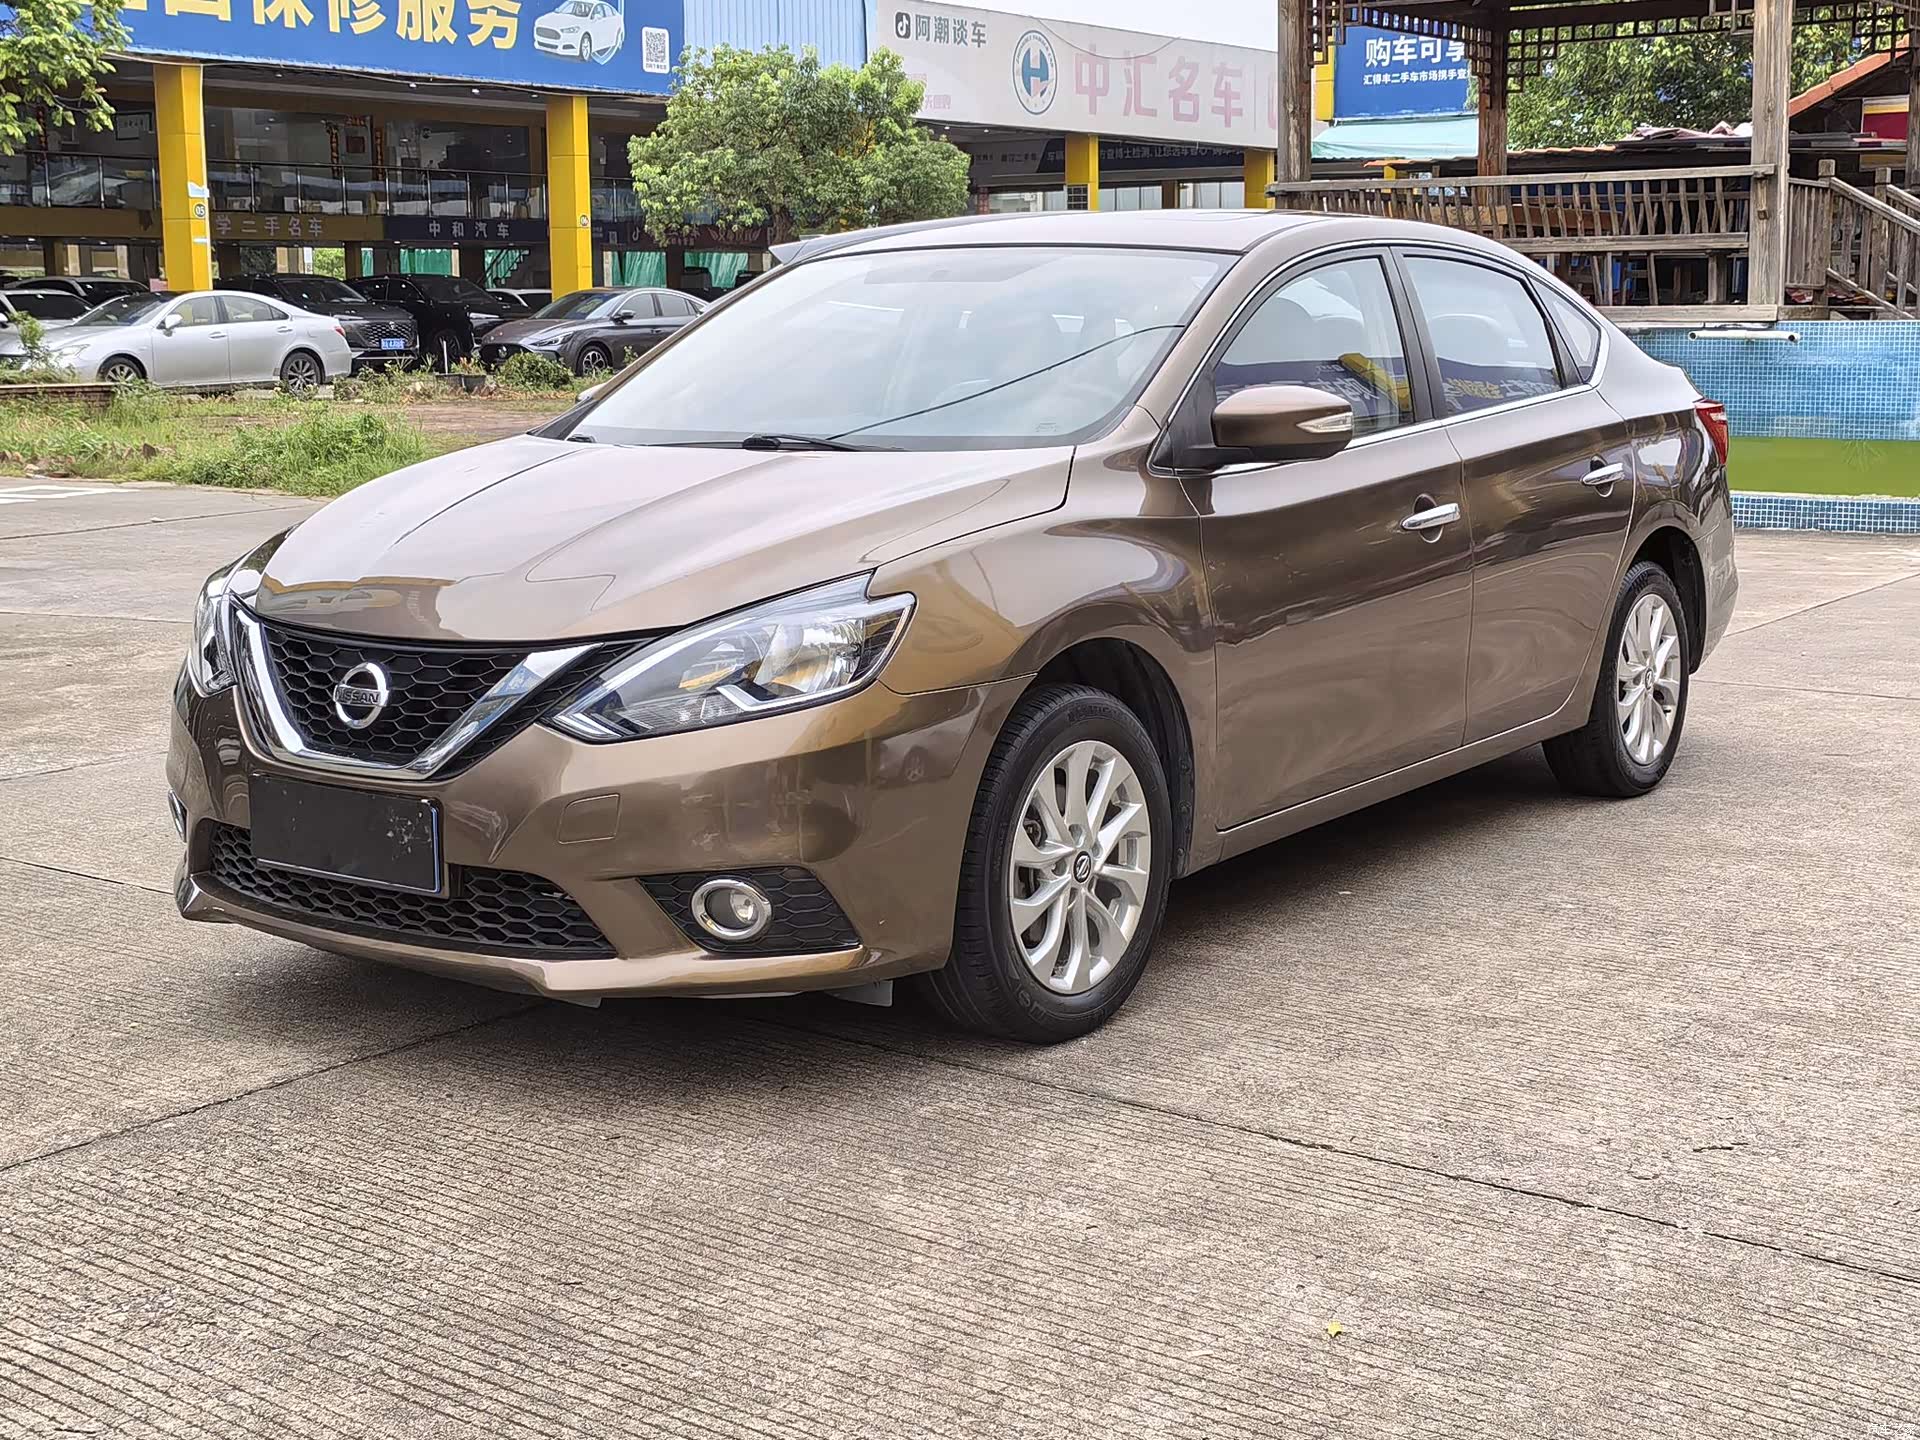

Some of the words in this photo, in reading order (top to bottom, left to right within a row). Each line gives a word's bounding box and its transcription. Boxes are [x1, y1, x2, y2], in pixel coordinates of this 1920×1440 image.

[915, 14, 987, 48] 阿潮谈车
[1074, 43, 1244, 128] 中汇名车
[195, 206, 205, 216] 05
[215, 214, 323, 237] 学二手名车
[428, 220, 510, 239] 中和汽车
[336, 687, 379, 703] NISSAN
